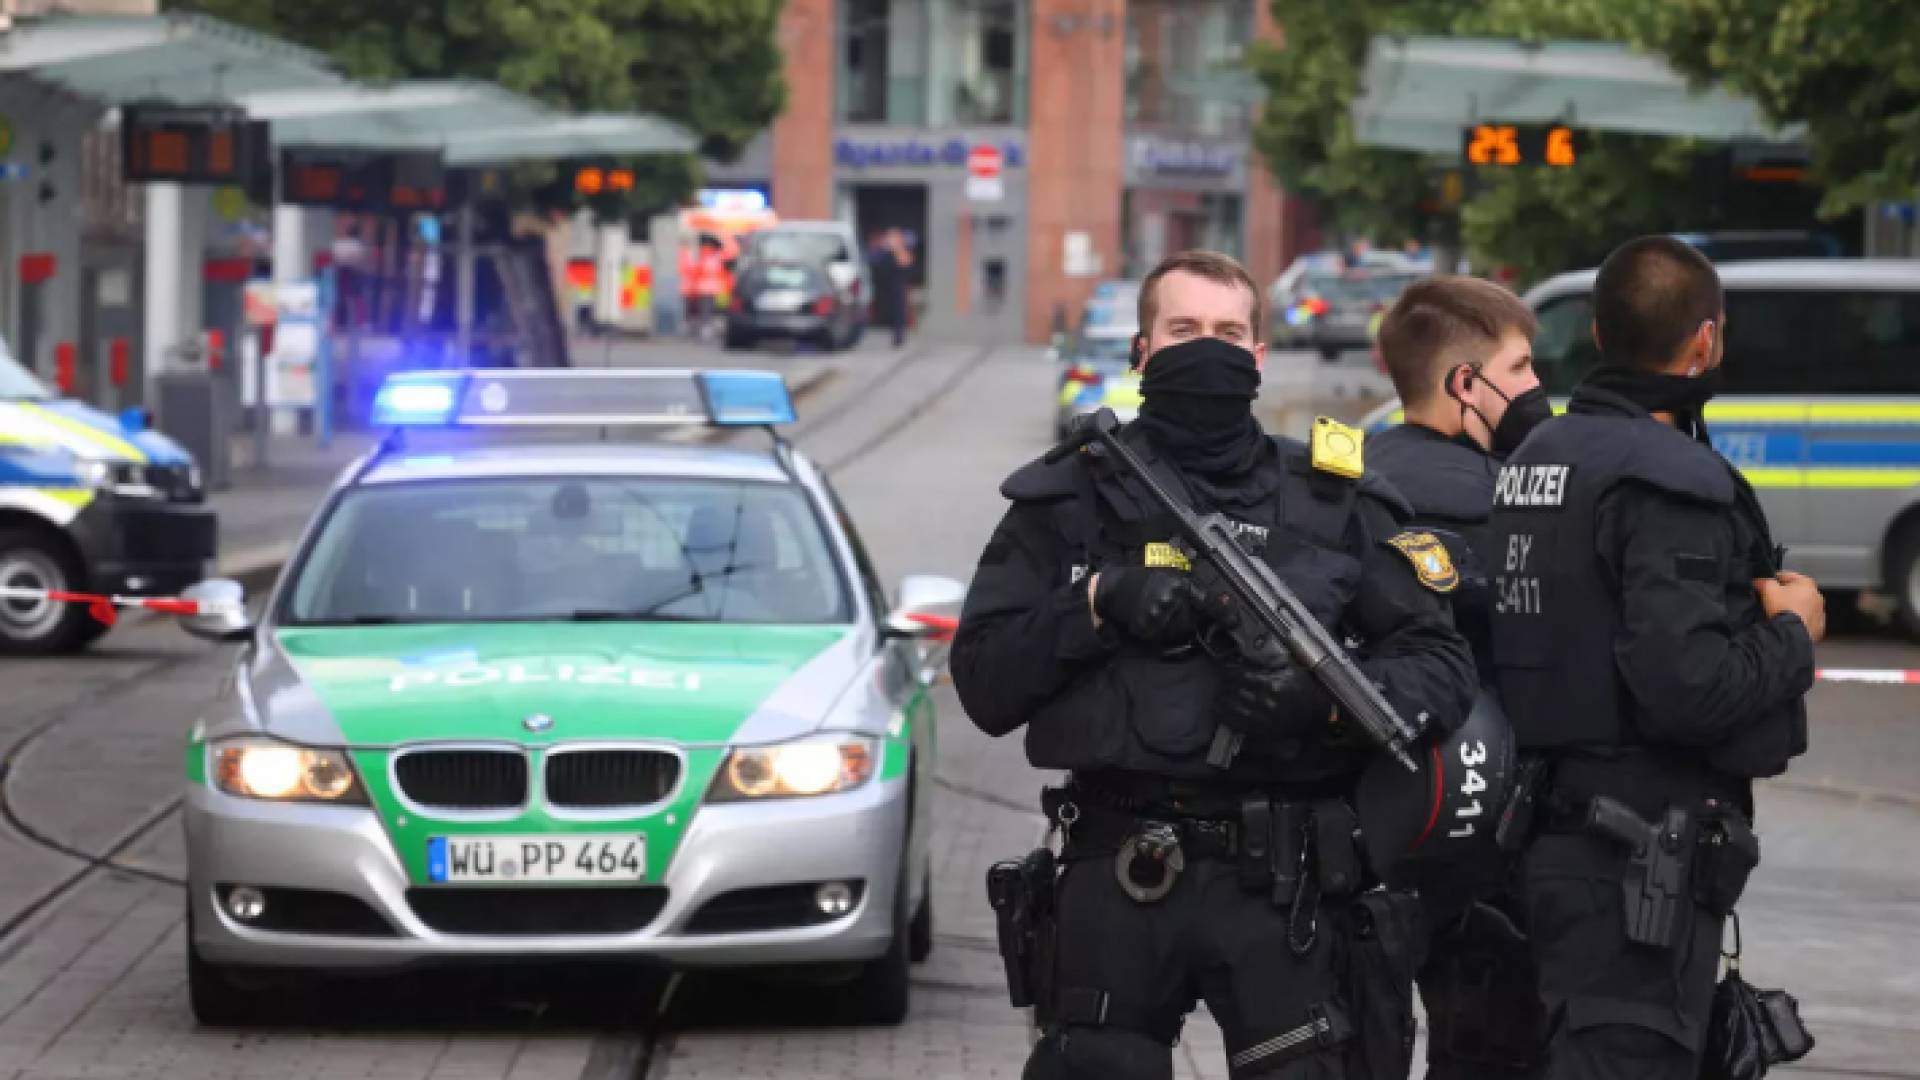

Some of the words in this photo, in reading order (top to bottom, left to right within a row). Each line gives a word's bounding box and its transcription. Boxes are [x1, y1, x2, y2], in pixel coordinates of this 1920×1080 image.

[1493, 465, 1570, 506] POLIZEI
[1506, 533, 1534, 571] BY
[1495, 576, 1541, 614] 3411
[389, 662, 702, 693] POLIZEI
[1448, 740, 1487, 838] 3411
[451, 841, 495, 876] WÜ
[521, 841, 567, 876] PP
[575, 841, 640, 875] 464
